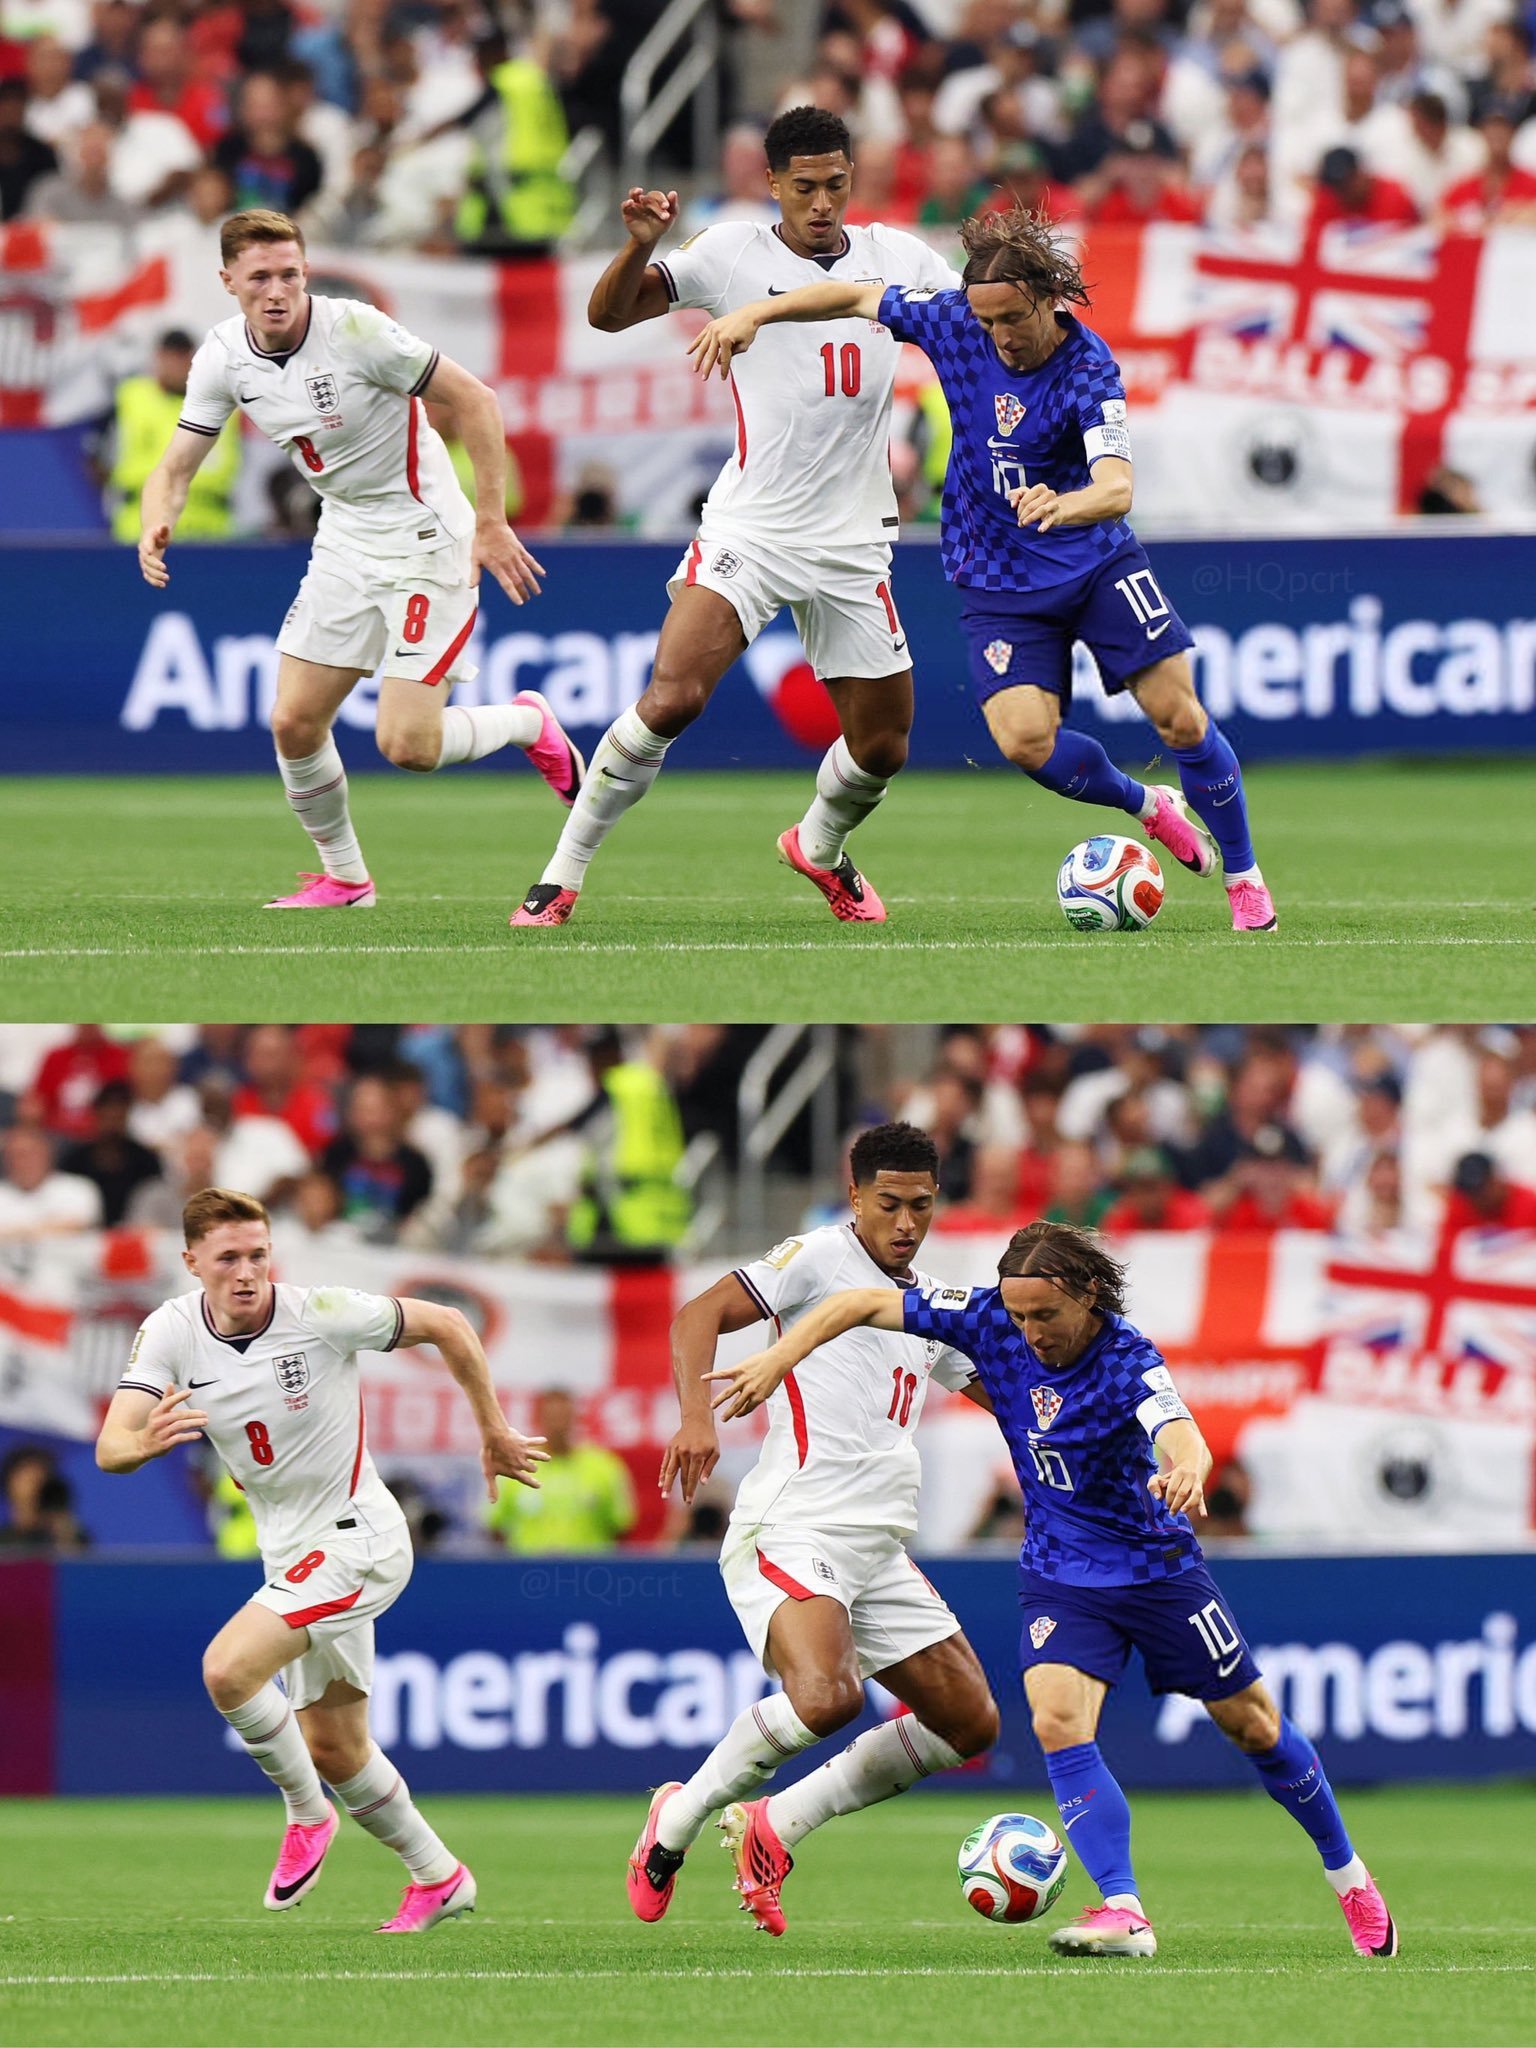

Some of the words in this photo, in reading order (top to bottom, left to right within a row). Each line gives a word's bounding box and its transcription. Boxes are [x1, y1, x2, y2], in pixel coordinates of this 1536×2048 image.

[820, 342, 861, 397] 10
[291, 436, 325, 472] 8
[990, 457, 1027, 499] 10
[403, 593, 430, 643] 8
[1115, 568, 1169, 624] 10
[1208, 773, 1235, 793] HNS
[887, 1366, 916, 1428] 10
[244, 1420, 274, 1465] 8
[1028, 1447, 1074, 1491] 10
[285, 1550, 325, 1584] 8
[1188, 1599, 1240, 1660] 10
[1289, 1766, 1316, 1791] HNS
